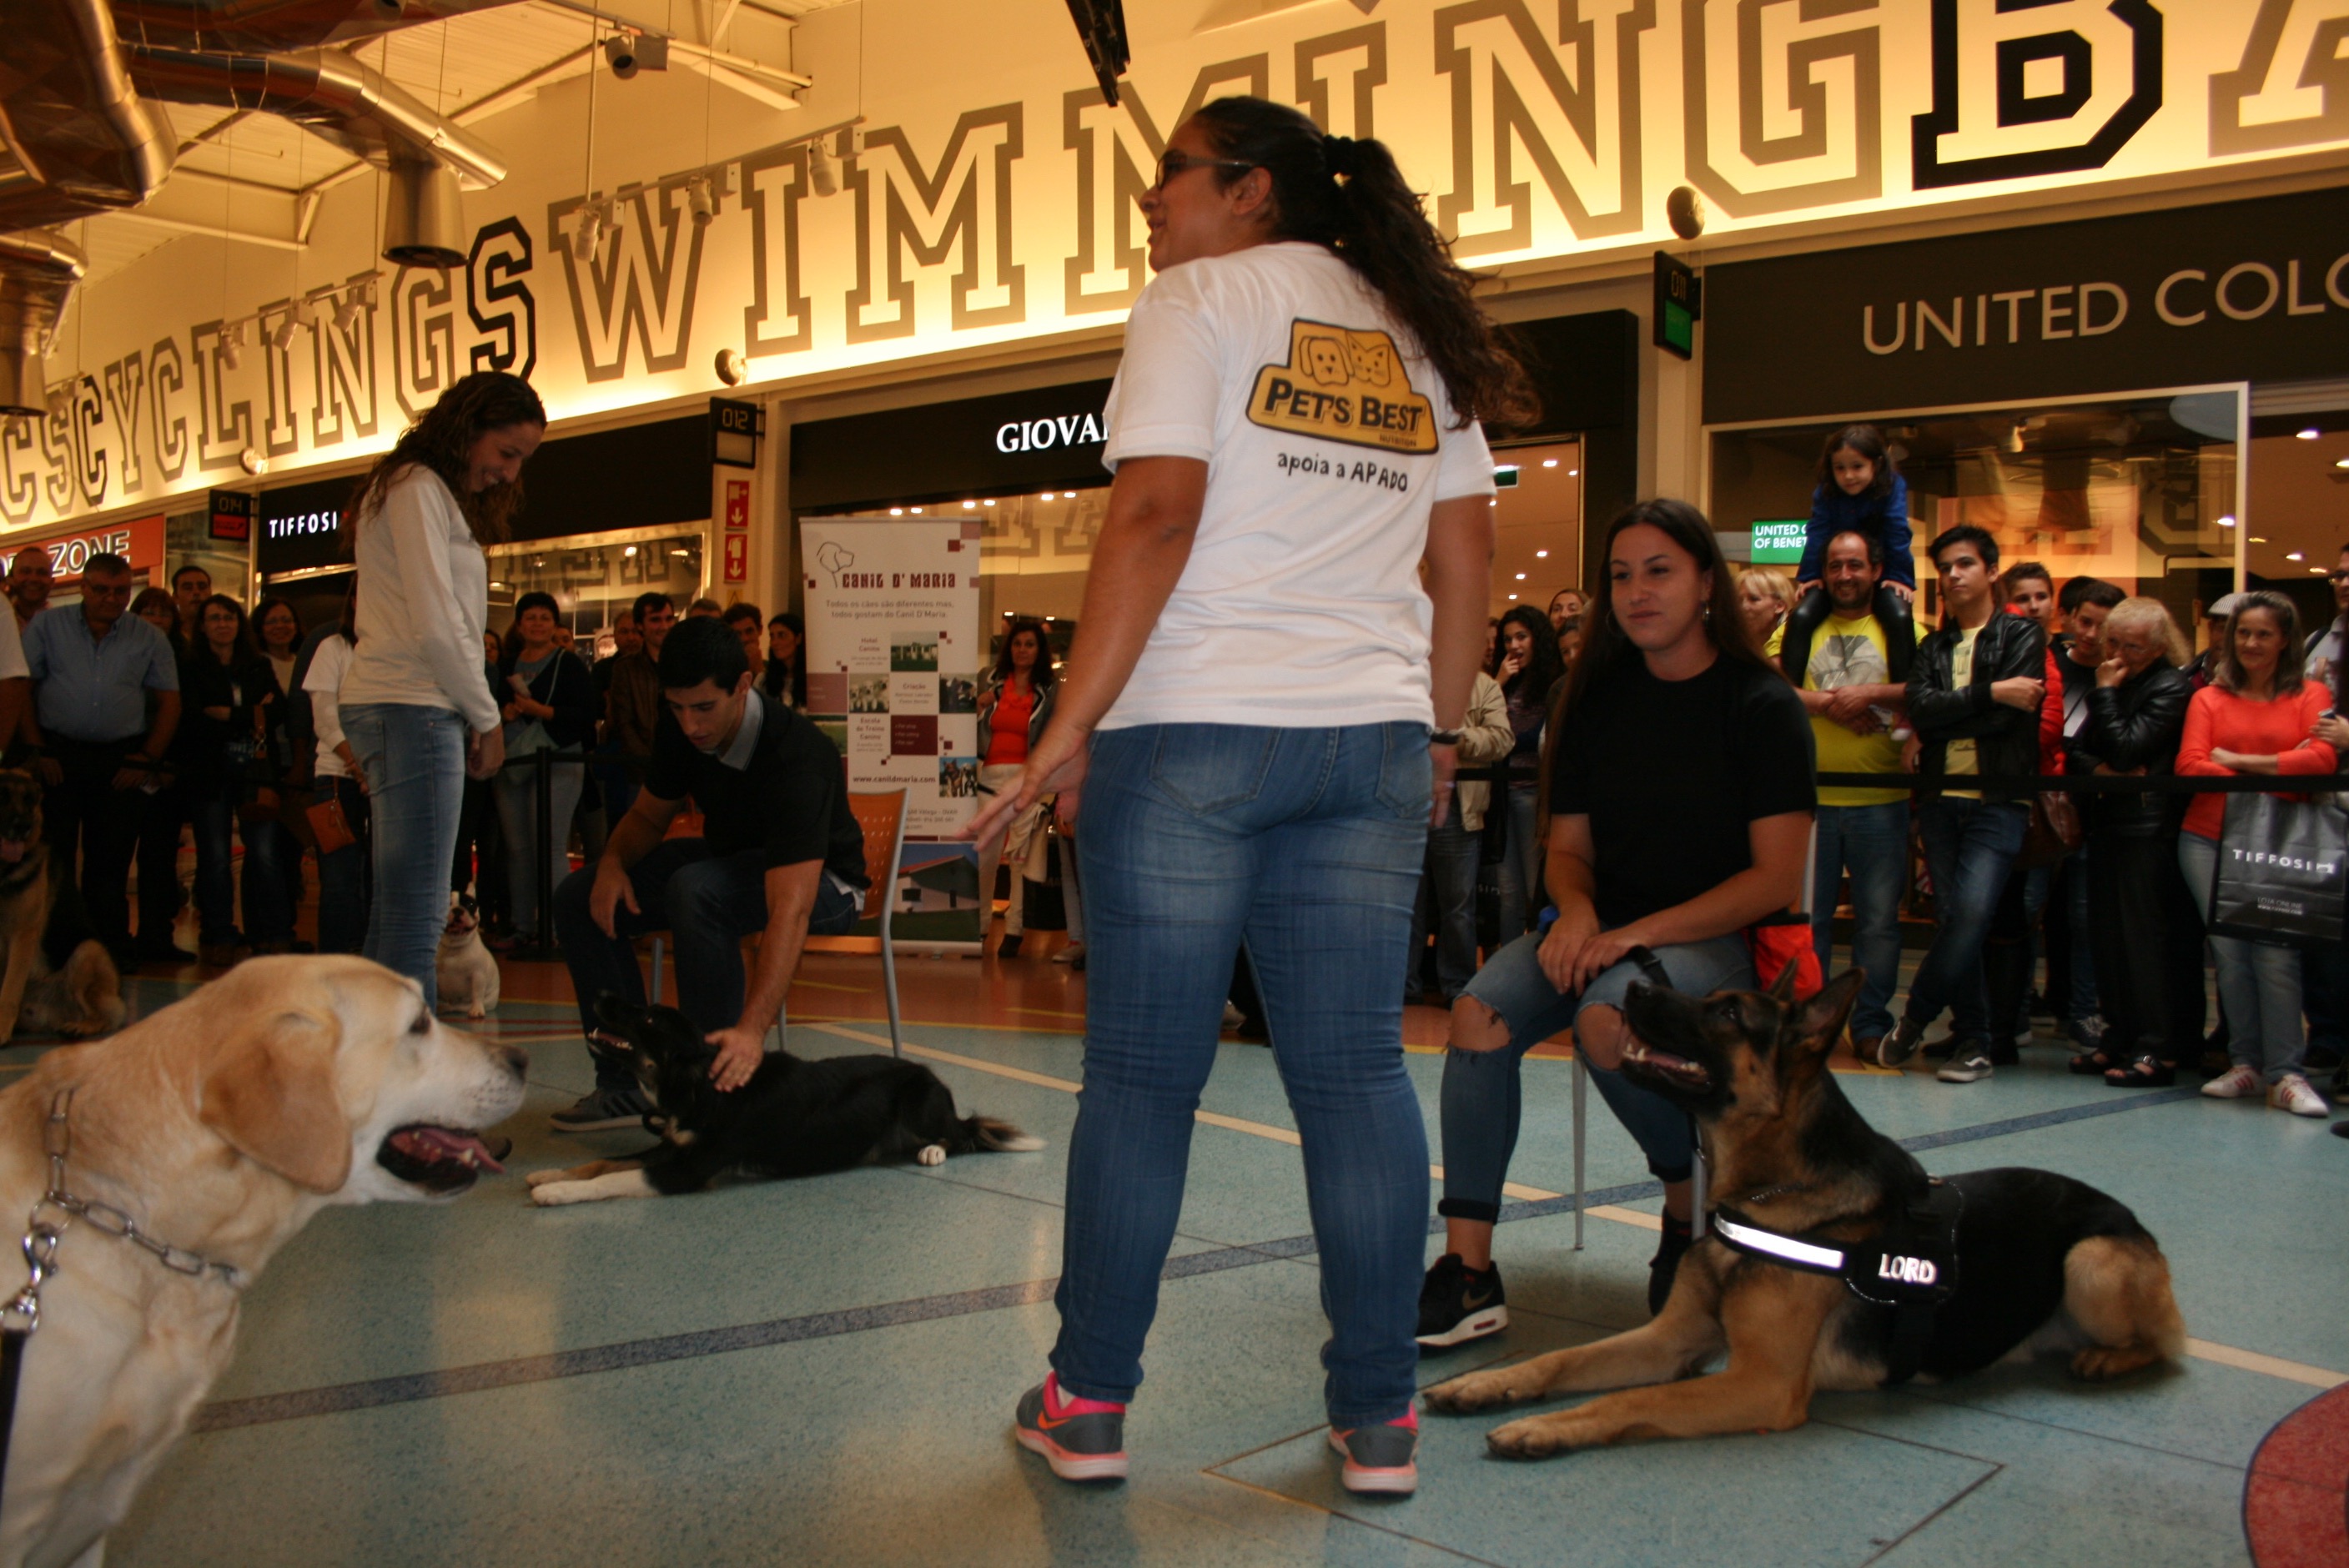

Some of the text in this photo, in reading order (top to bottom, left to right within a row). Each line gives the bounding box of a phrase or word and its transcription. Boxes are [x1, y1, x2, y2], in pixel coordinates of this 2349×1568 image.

[1863, 282, 2129, 355] UNITED
[73, 264, 455, 507] CYCLING
[1265, 378, 1423, 432] PET'S BEST
[722, 408, 748, 430] 012
[996, 413, 1109, 452] GIOVA
[1278, 453, 1408, 492] apoia a APADO
[219, 497, 243, 513] 014
[269, 510, 337, 538] TIFFOSI
[1755, 525, 1799, 535] UNITED
[48, 530, 130, 577] ZONE
[1754, 538, 1770, 548] OF
[827, 600, 848, 608] Todos
[896, 600, 933, 608] diferentes
[855, 611, 883, 620] gostam
[896, 610, 915, 618] Canil
[853, 776, 936, 784] www.canildmaria.com
[2232, 848, 2311, 871] TIFFOSI
[1879, 1253, 1936, 1284] LORD
